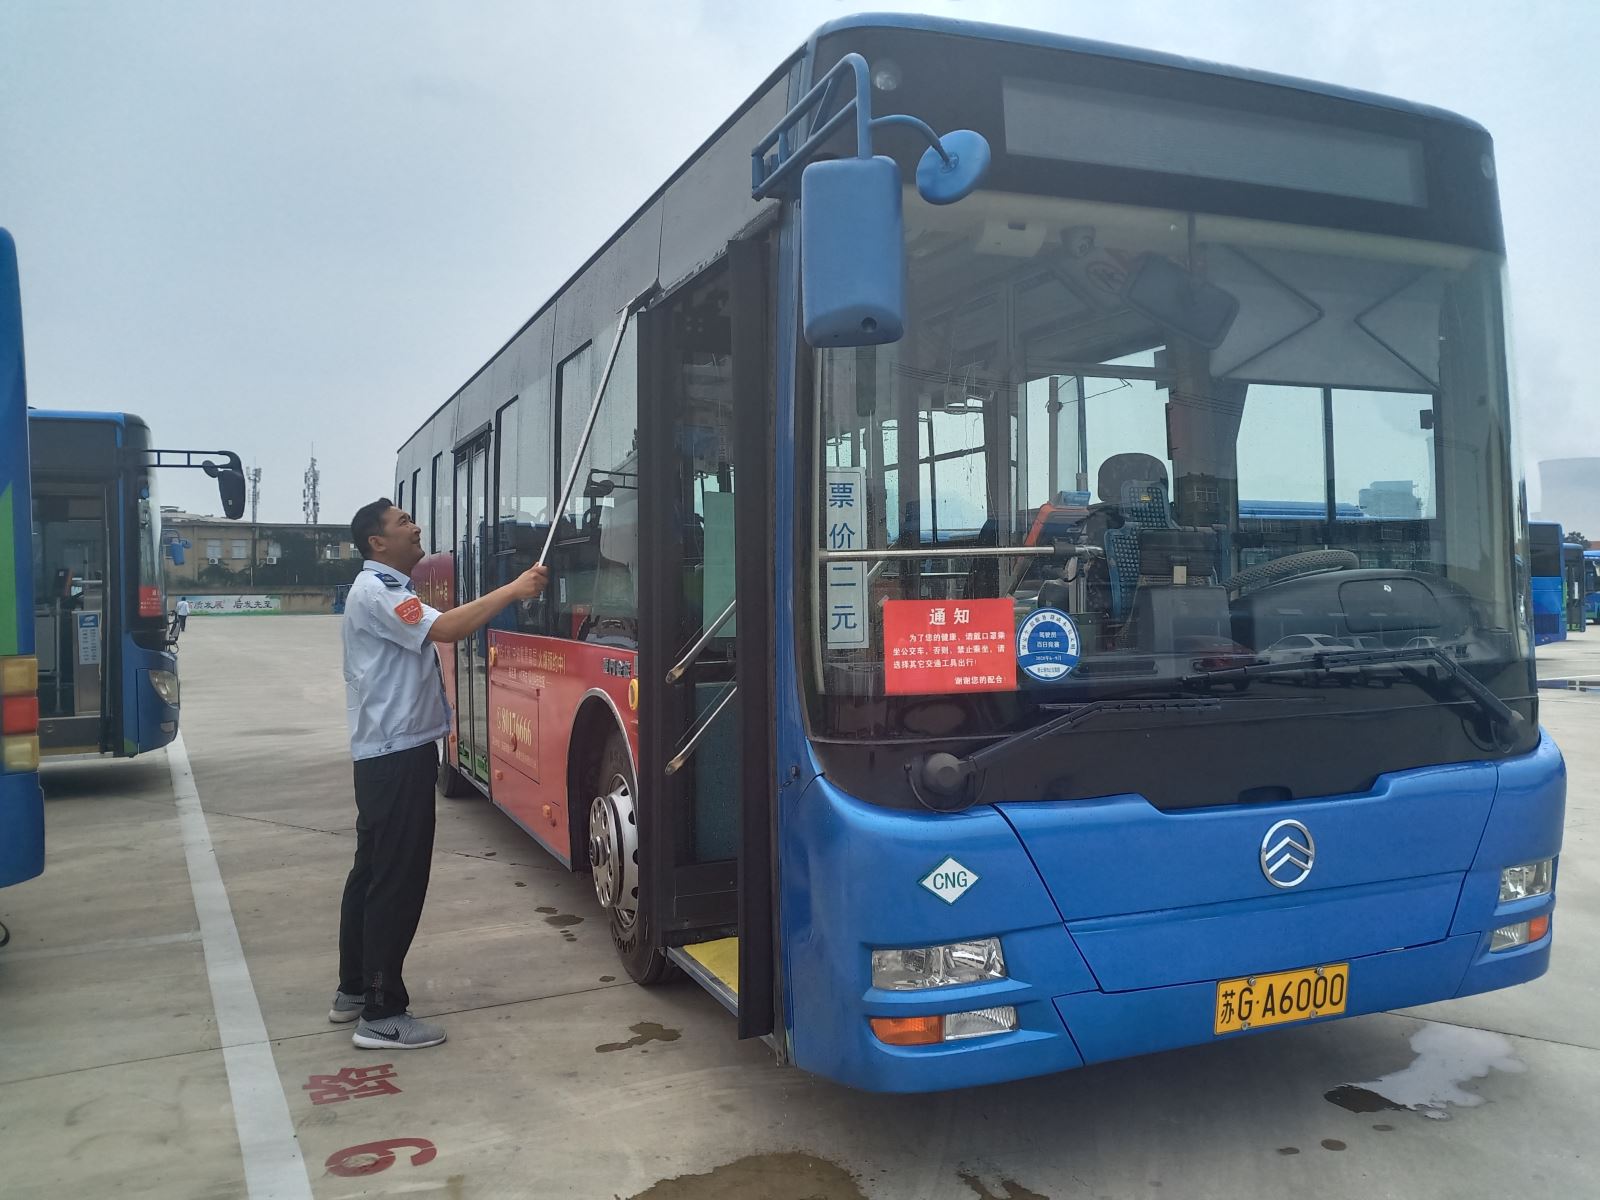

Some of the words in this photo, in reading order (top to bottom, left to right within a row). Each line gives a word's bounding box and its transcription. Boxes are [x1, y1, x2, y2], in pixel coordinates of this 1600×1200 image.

[829, 482, 858, 631] 票价二元
[929, 607, 970, 625] 通知
[933, 870, 968, 890] CNG
